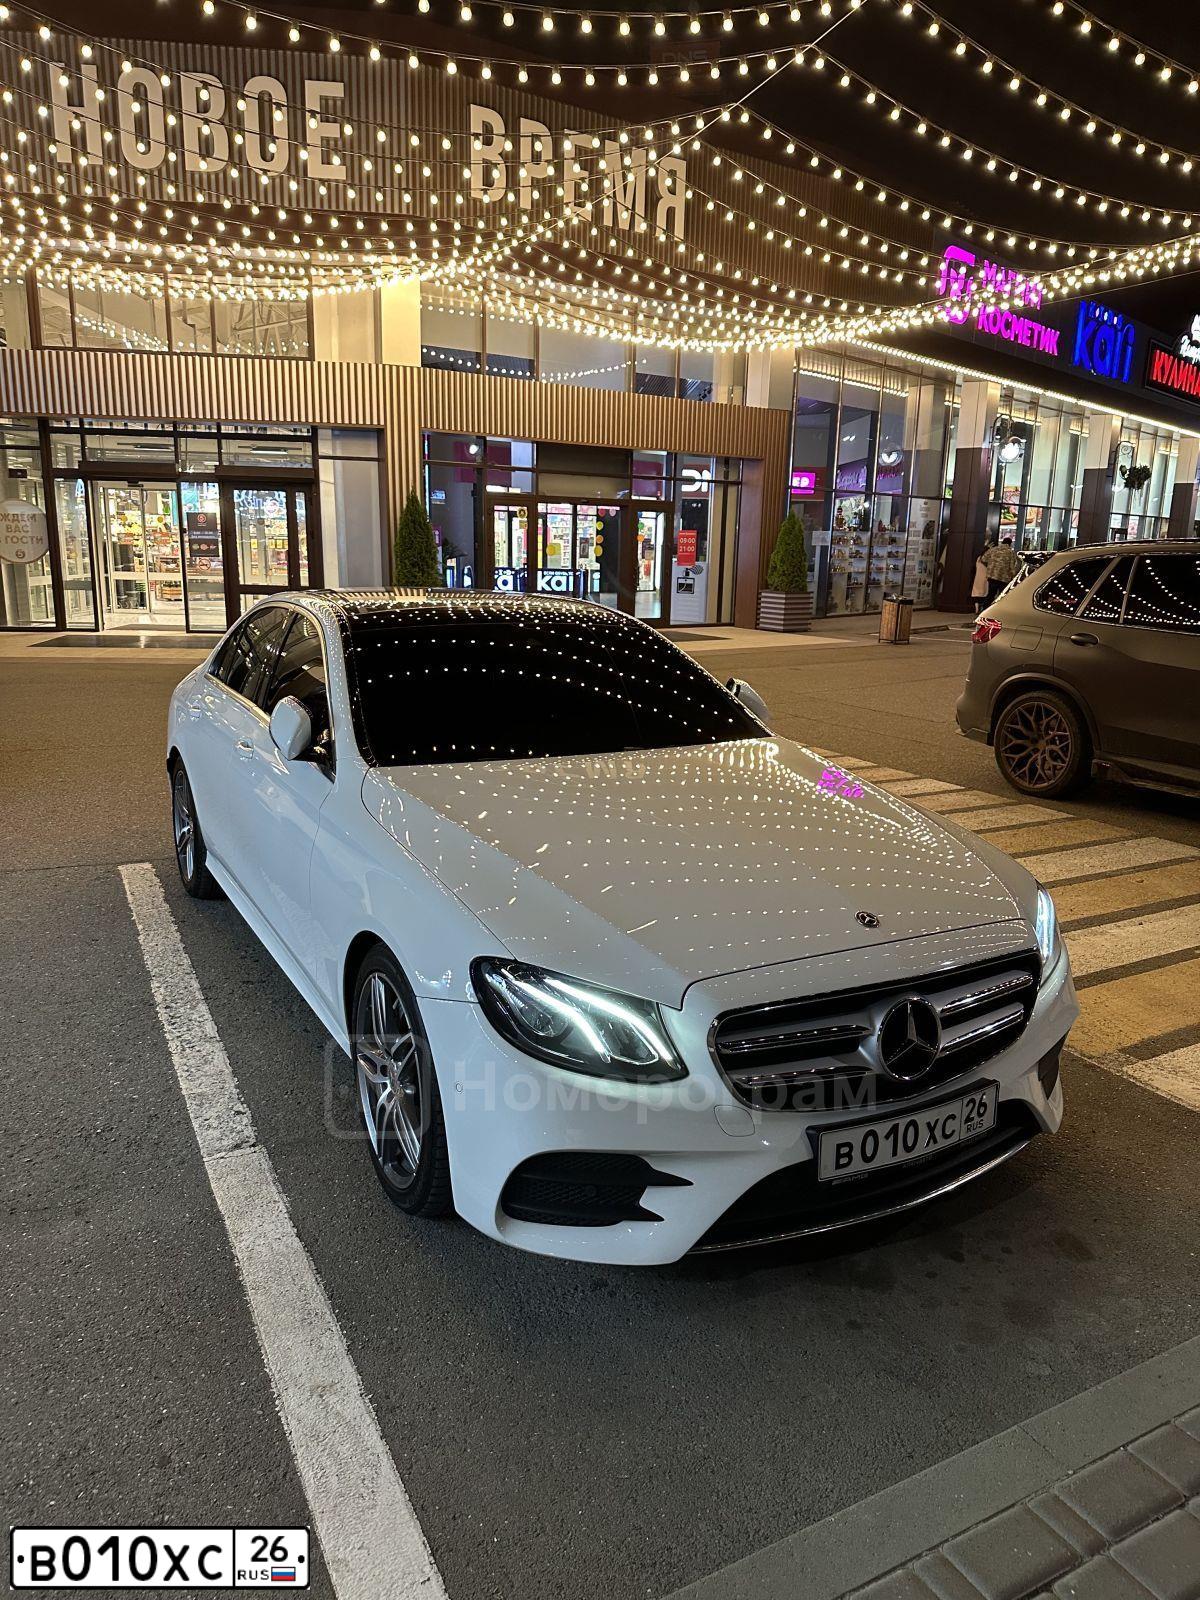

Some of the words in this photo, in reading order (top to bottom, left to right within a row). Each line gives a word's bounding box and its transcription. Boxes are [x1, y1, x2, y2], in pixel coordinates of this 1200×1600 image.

[50, 61, 347, 181] НОВОЕ
[469, 103, 687, 242] ВРЕМЯ
[977, 302, 1060, 356] КОСМЕТИК
[5, 535, 44, 545] ГОСТИ
[6, 524, 29, 533] ВАС
[963, 1092, 988, 1125] 26
[966, 1119, 984, 1134] RUS
